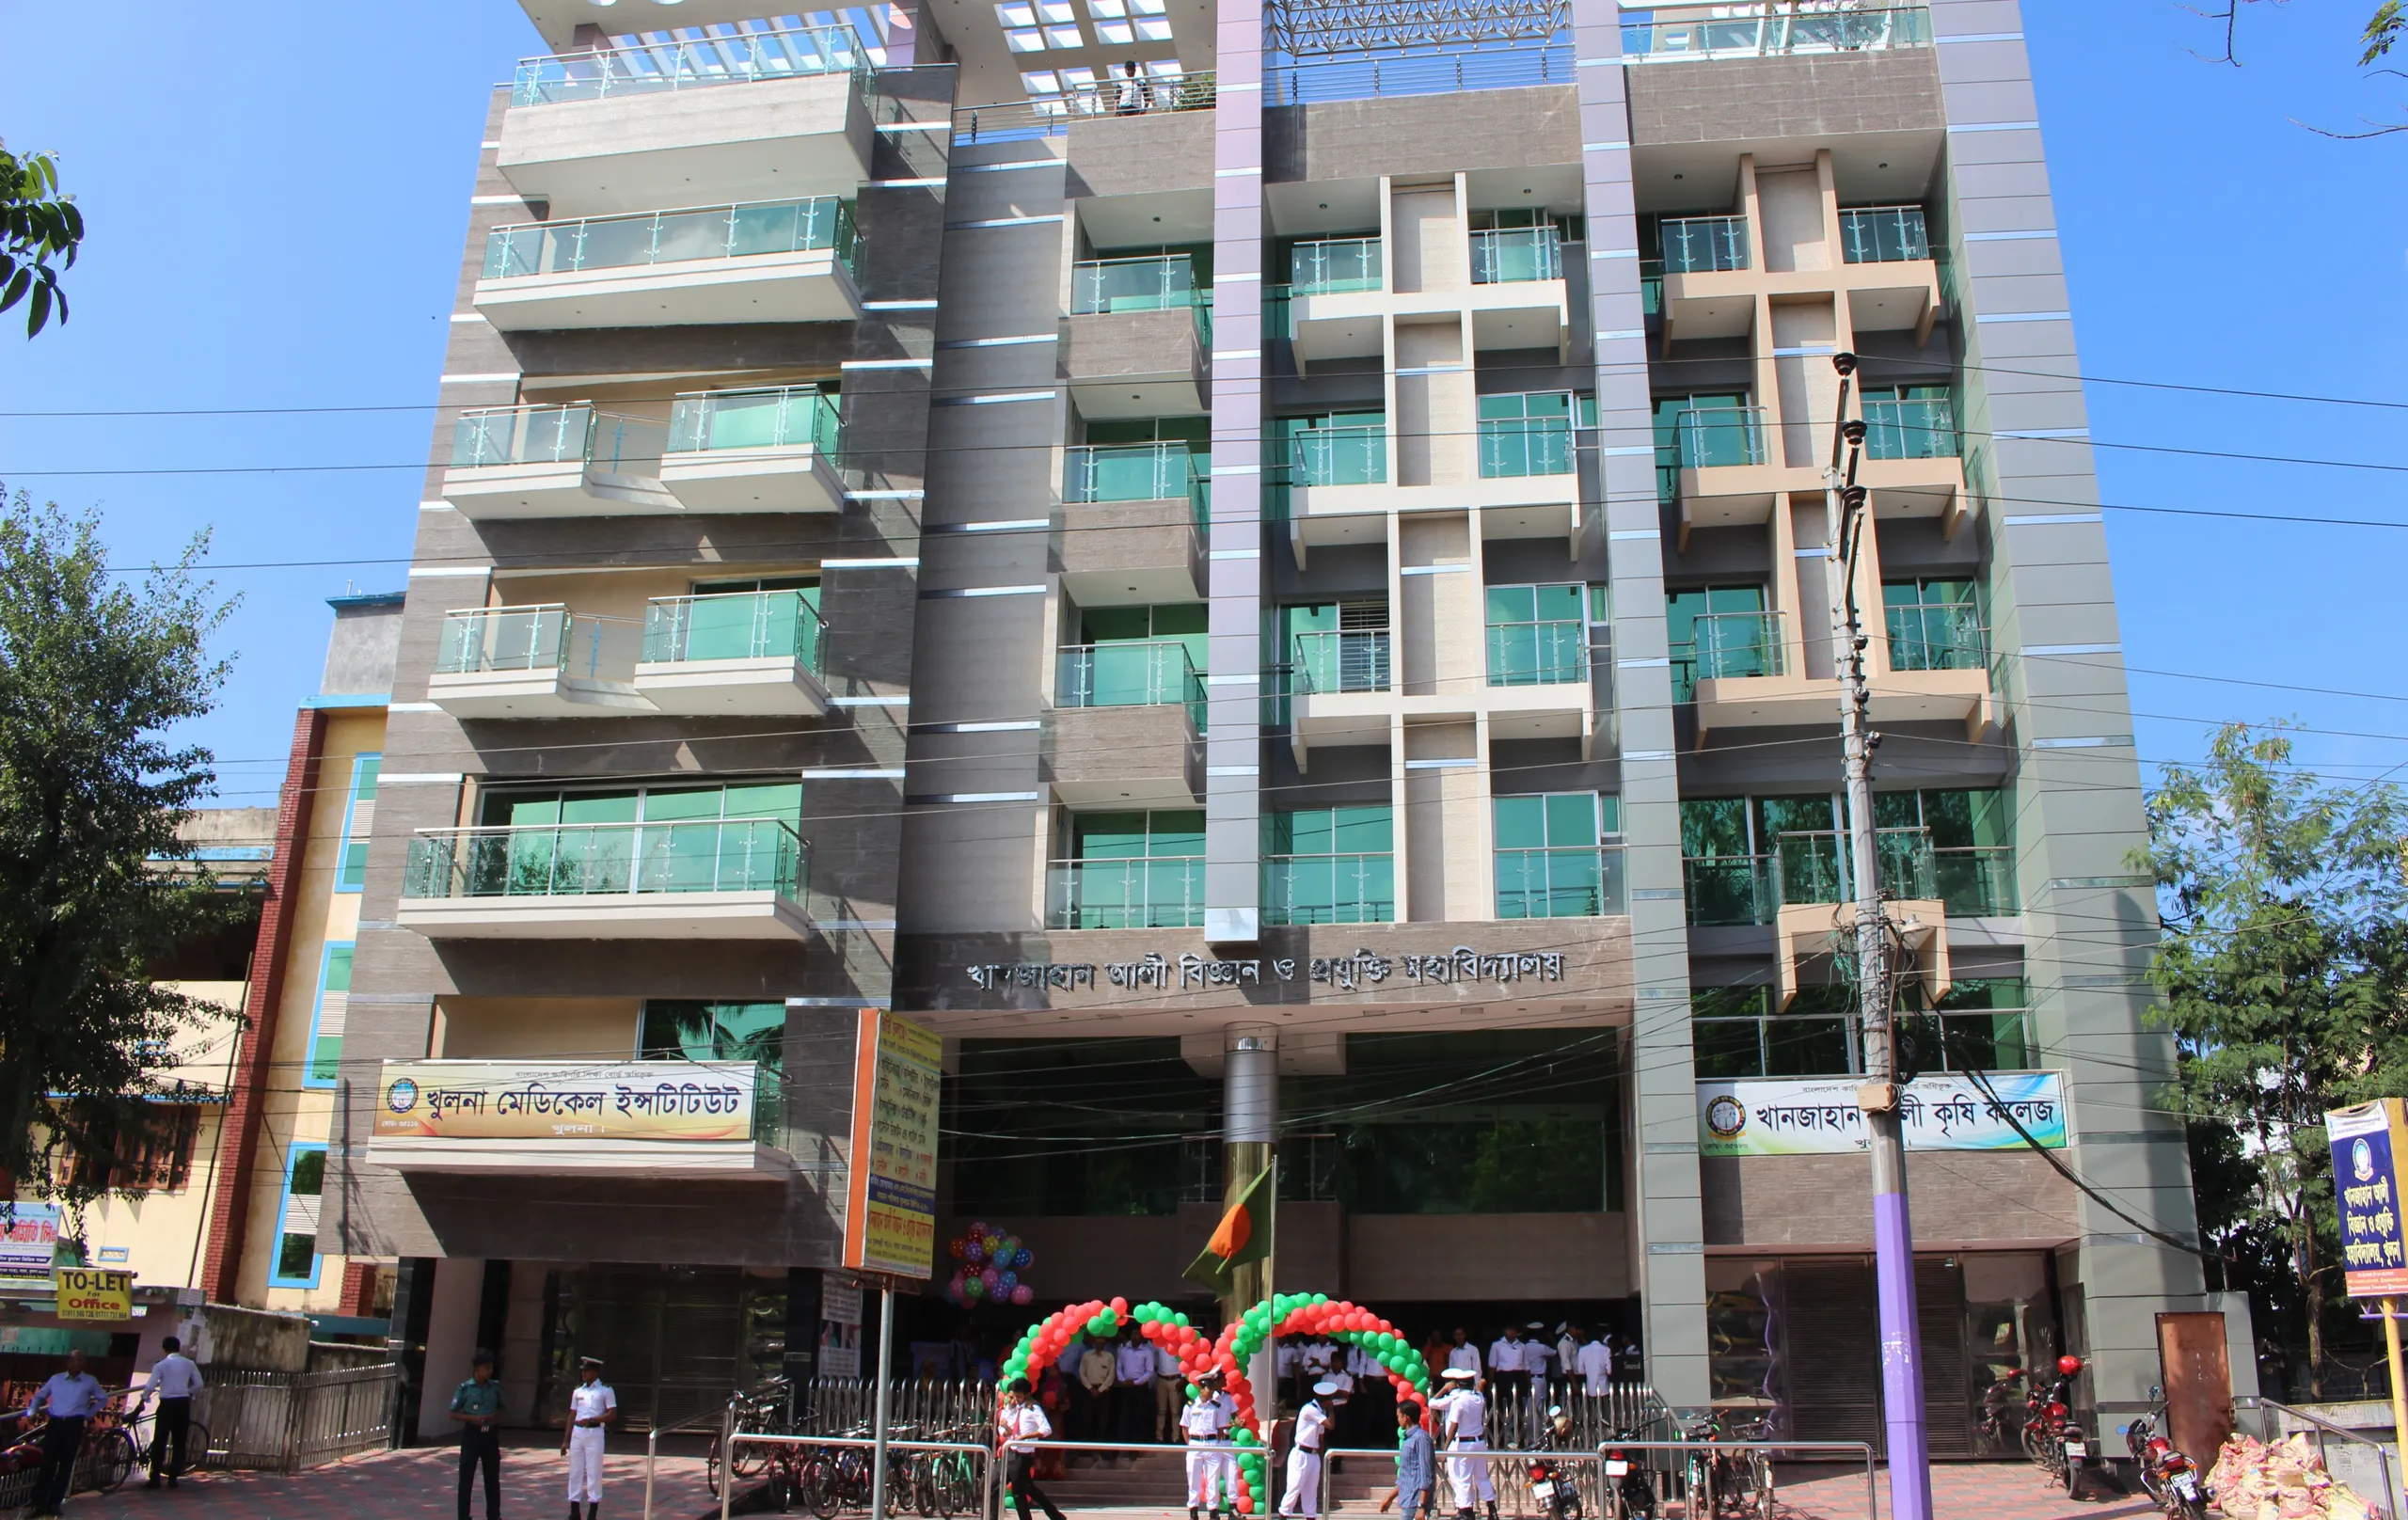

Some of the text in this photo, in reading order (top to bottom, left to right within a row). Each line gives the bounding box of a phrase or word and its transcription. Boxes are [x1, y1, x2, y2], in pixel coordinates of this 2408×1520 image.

[967, 945, 1565, 991] খানজাহান আলী বিজ্ঞান ও প্রযুক্তি মহাবিদ্যালয়
[427, 1083, 742, 1121] খুলনা মেডিকেল ইন্সটিটিউট
[1756, 1102, 1861, 1133] খানজাহান
[1900, 1093, 1925, 1128] লী
[1931, 1093, 1977, 1139] কৃষি
[551, 1124, 594, 1135] খুলনা
[2344, 1176, 2389, 1209] খানজাহান আলী
[2347, 1211, 2368, 1237] বিজ্ঞান
[2368, 1215, 2375, 1233] ও
[2383, 1239, 2401, 1268] খুলনা
[62, 1271, 128, 1291] TO-LET
[69, 1298, 120, 1309] Office
